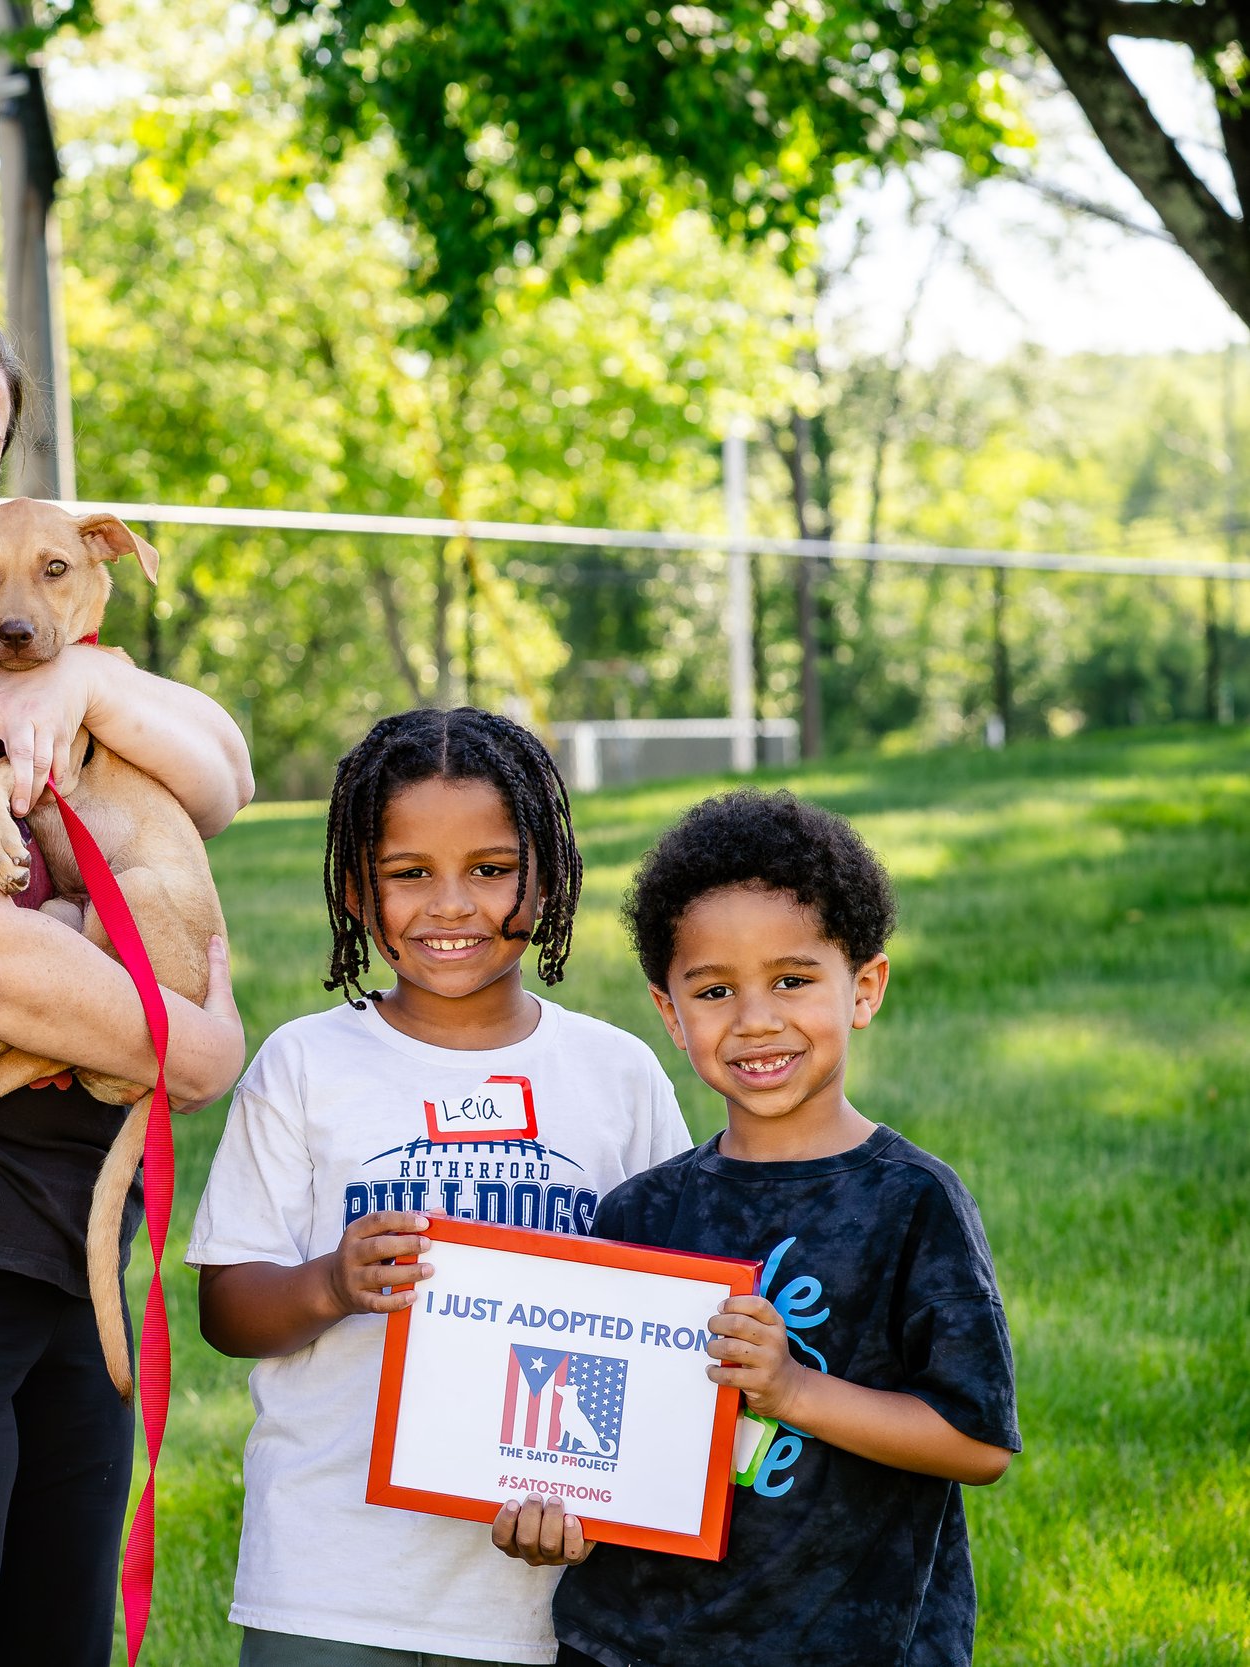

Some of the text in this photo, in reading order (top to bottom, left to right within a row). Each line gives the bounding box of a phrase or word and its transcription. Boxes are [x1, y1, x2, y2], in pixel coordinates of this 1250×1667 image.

[442, 1095, 502, 1122] Leia
[400, 1160, 550, 1181] RUTHERFORD
[426, 1290, 434, 1314] I
[438, 1293, 503, 1322] JUST
[507, 1303, 634, 1341] ADOPTED
[499, 1446, 618, 1472] THE SATO PROJECT
[498, 1474, 612, 1503] #SATOSTRONG
